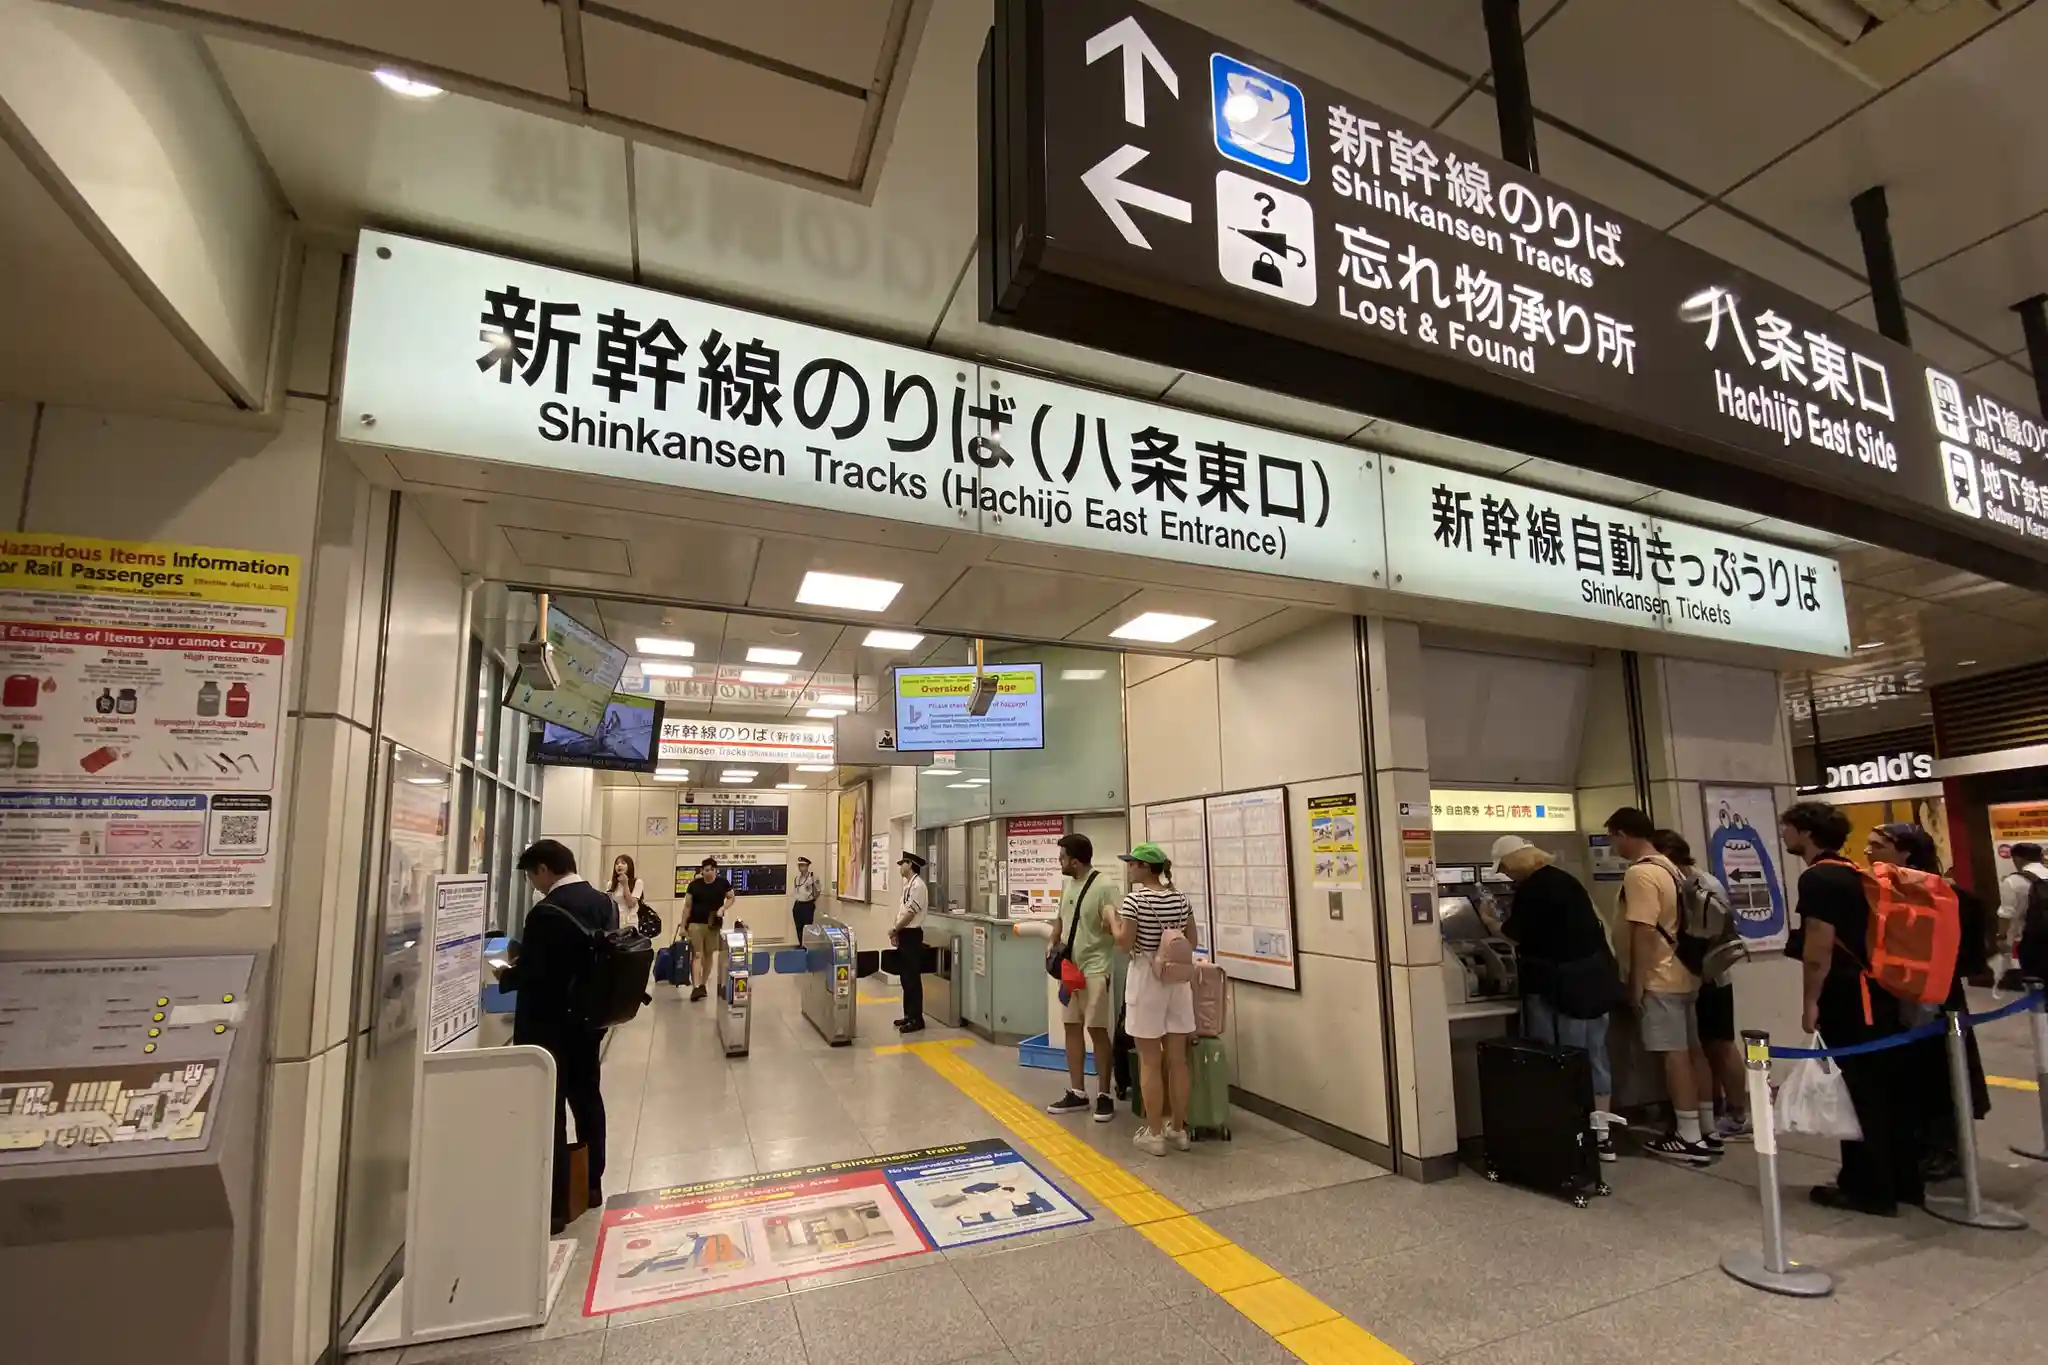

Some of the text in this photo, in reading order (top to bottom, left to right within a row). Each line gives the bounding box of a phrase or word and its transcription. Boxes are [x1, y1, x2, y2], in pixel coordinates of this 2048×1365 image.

[1328, 105, 1625, 268] 新幹線のりば
[1331, 165, 1594, 288] Shinkansen Tracks
[1334, 223, 1637, 375] 忘れ物承り所
[1338, 285, 1536, 374] Lost & Found
[1704, 286, 1895, 423] 八条東口
[1714, 369, 1898, 473] Hachijō East Side
[1975, 428, 2022, 464] JR Lines
[538, 402, 786, 476] Shinkansen
[806, 446, 928, 501] Tracks
[1086, 498, 1149, 537] East
[1161, 511, 1287, 560] Entrance)
[1986, 500, 2026, 536] Subway
[110, 547, 166, 567] Items
[172, 552, 290, 577] Information
[1432, 483, 1821, 612] 新幹線自動きっぷうりば
[25, 560, 63, 577] Rail
[71, 563, 184, 588] Passengers
[1581, 580, 1732, 625] Shinkansen Tickets
[10, 626, 267, 652] Examples of Items you cannot carry
[921, 684, 970, 693] Oversized
[661, 744, 715, 756] Shinkansen
[719, 747, 747, 757] Tracks
[55, 796, 78, 806] that
[81, 799, 99, 807] are
[102, 796, 148, 807] allowed
[151, 796, 197, 807] onboard
[660, 1178, 735, 1196] Baggage
[740, 1168, 802, 1184] storage
[807, 1164, 827, 1174] on
[926, 1144, 967, 1157] trains
[903, 1159, 954, 1173] Reservation
[955, 1153, 992, 1164] Required
[994, 1150, 1013, 1158] Area
[653, 1193, 739, 1212] Reservation
[744, 1183, 804, 1197] Required
[809, 1176, 840, 1187] Area
